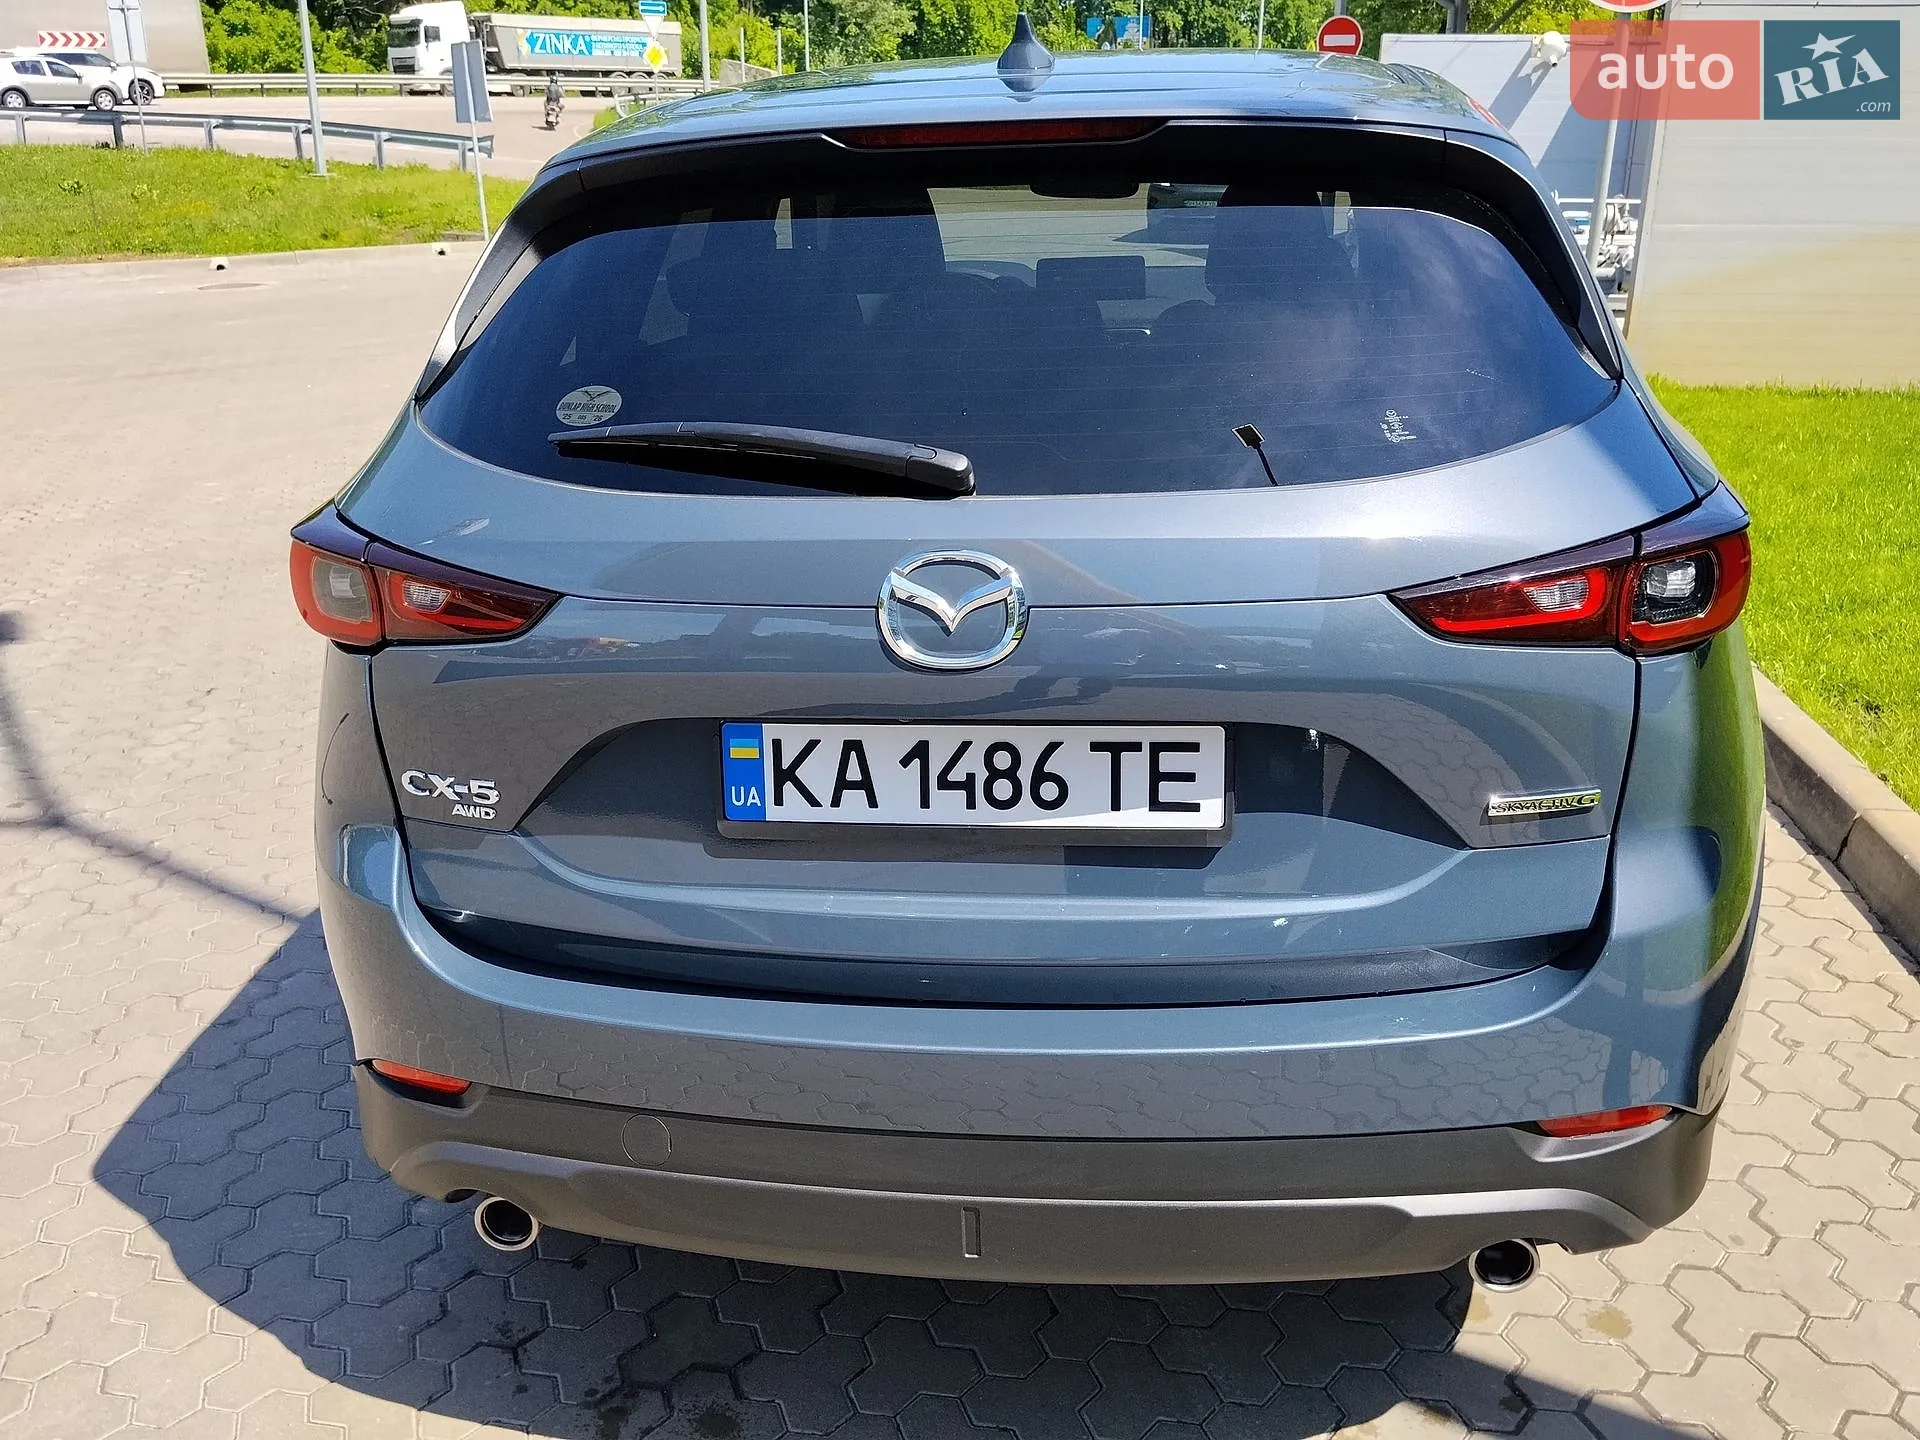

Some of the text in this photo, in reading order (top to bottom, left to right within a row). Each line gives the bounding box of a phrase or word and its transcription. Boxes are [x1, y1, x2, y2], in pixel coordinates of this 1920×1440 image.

[533, 33, 590, 56] ZINKA
[580, 402, 596, 412] HIGH
[594, 402, 617, 413] SCHOOL
[771, 738, 1202, 813] KA 1486 TE
[401, 770, 500, 805] CX-5
[731, 785, 761, 806] UA
[452, 804, 497, 820] AWD
